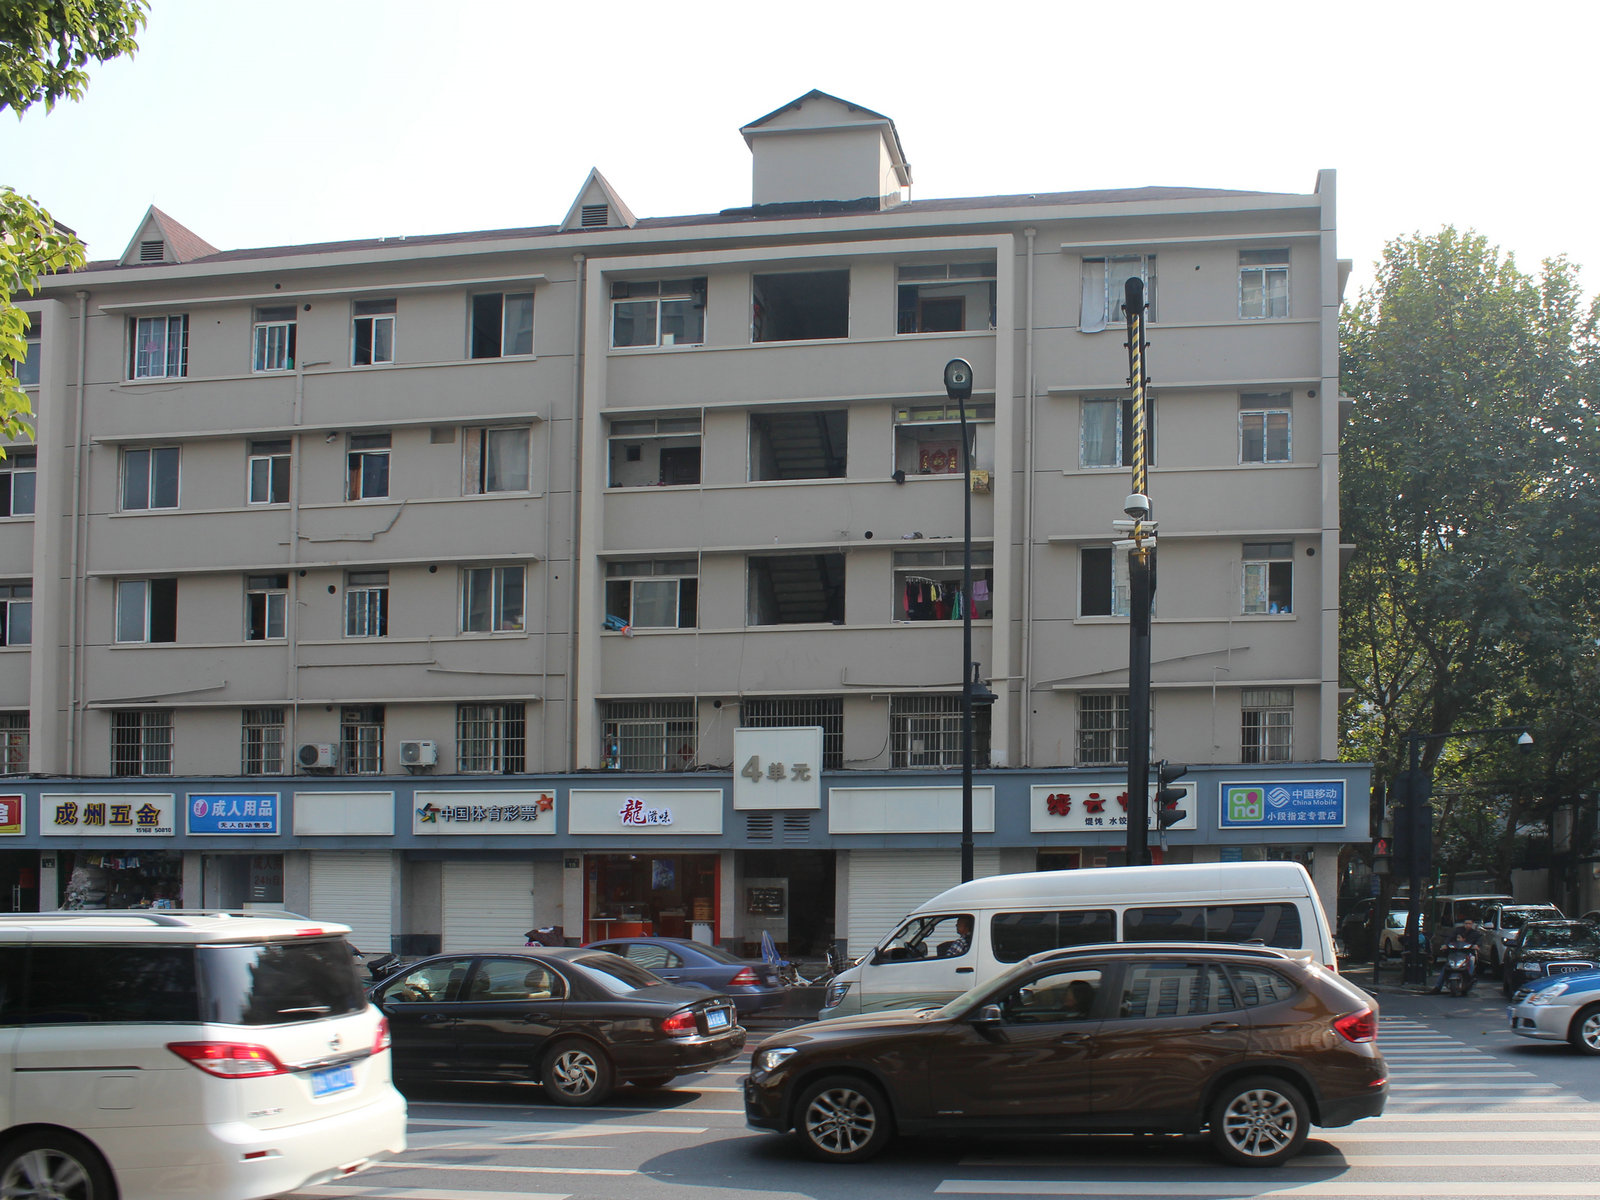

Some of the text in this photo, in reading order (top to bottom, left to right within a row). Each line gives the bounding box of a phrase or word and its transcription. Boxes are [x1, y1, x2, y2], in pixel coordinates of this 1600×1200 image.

[741, 755, 811, 783] 4单元
[1292, 789, 1337, 799] 中国移动
[54, 802, 160, 826] 成州五金
[211, 800, 272, 816] 成人用品
[440, 805, 537, 822] 中国体育彩票
[1267, 811, 1337, 821] 小段指定专营店
